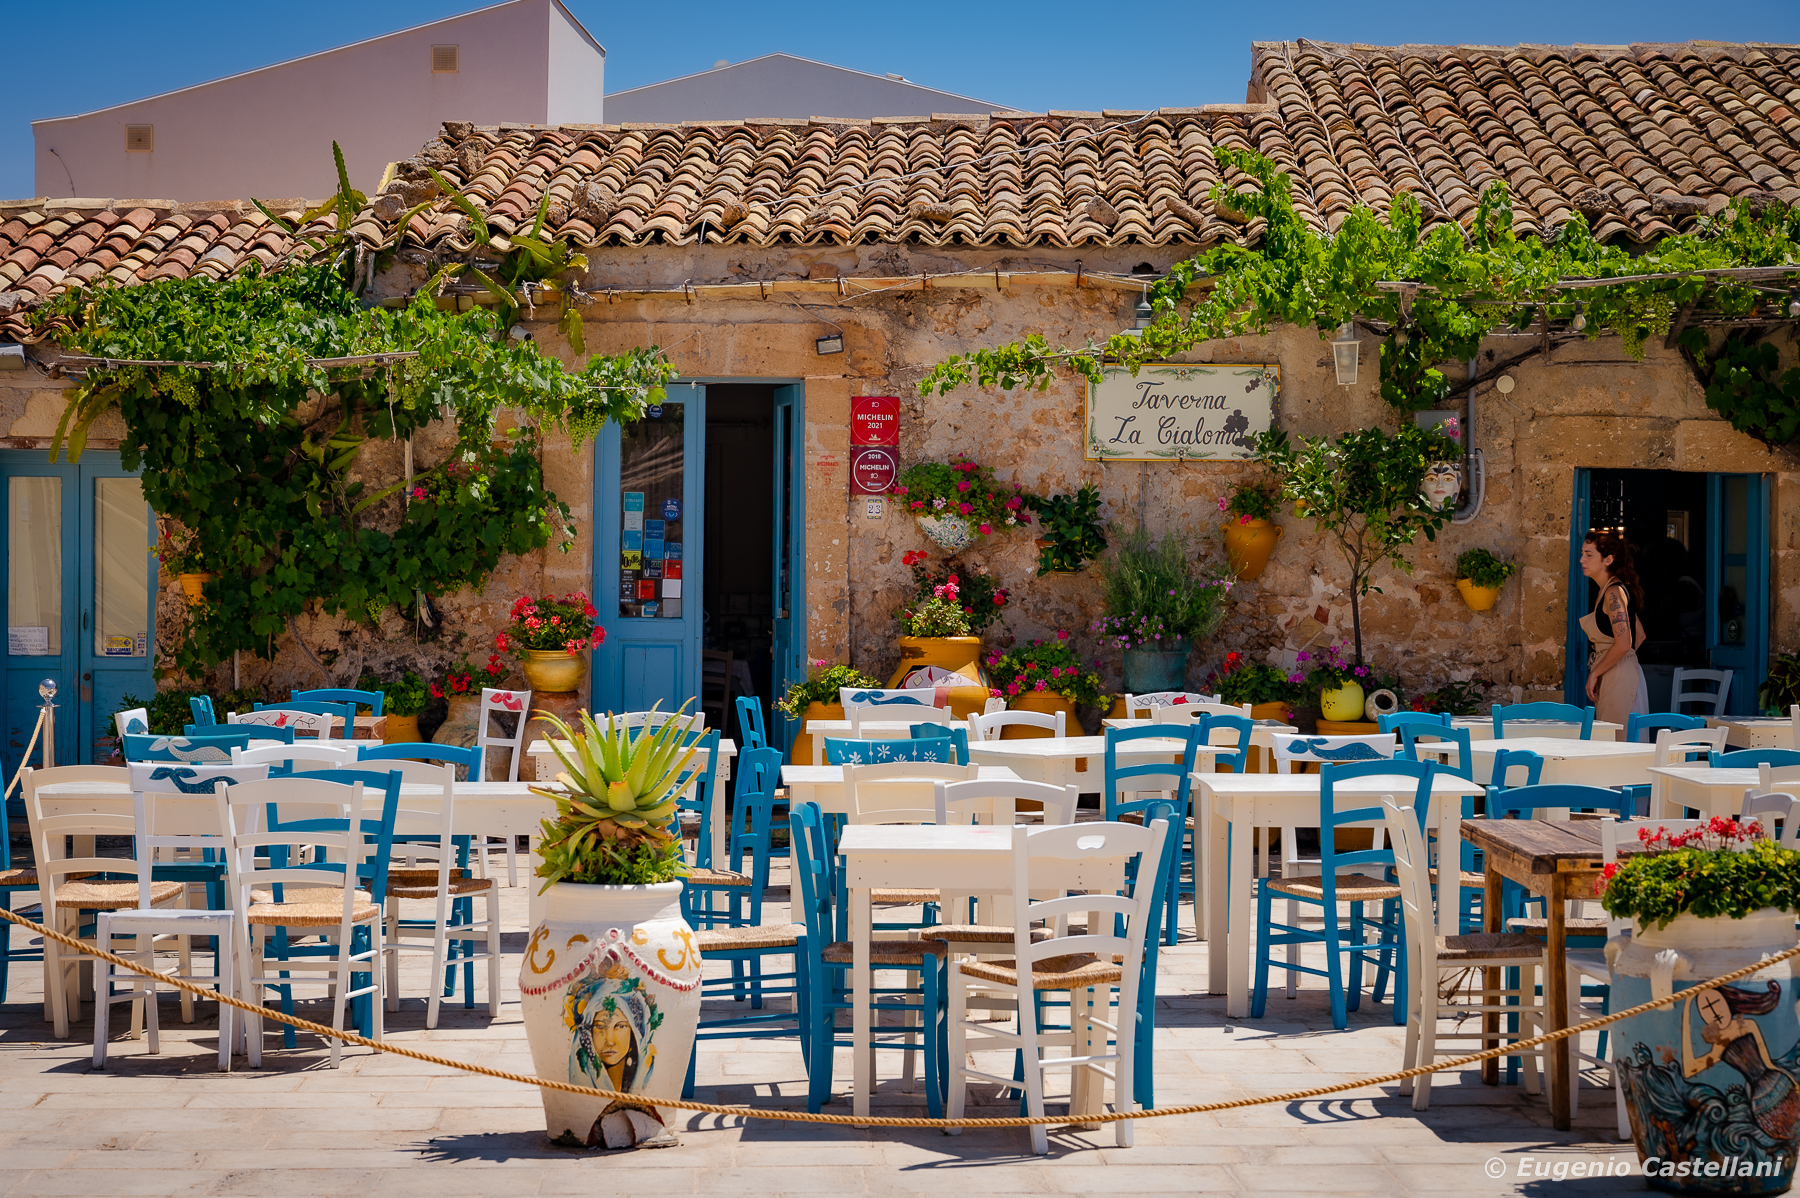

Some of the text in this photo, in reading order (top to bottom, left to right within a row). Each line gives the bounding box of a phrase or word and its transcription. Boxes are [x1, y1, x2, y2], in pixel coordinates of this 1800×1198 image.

[1131, 381, 1230, 410] Taverna
[857, 413, 893, 421] MICHELIN
[1108, 415, 1145, 444] La
[868, 504, 881, 514] 23
[106, 638, 123, 647] Pago
